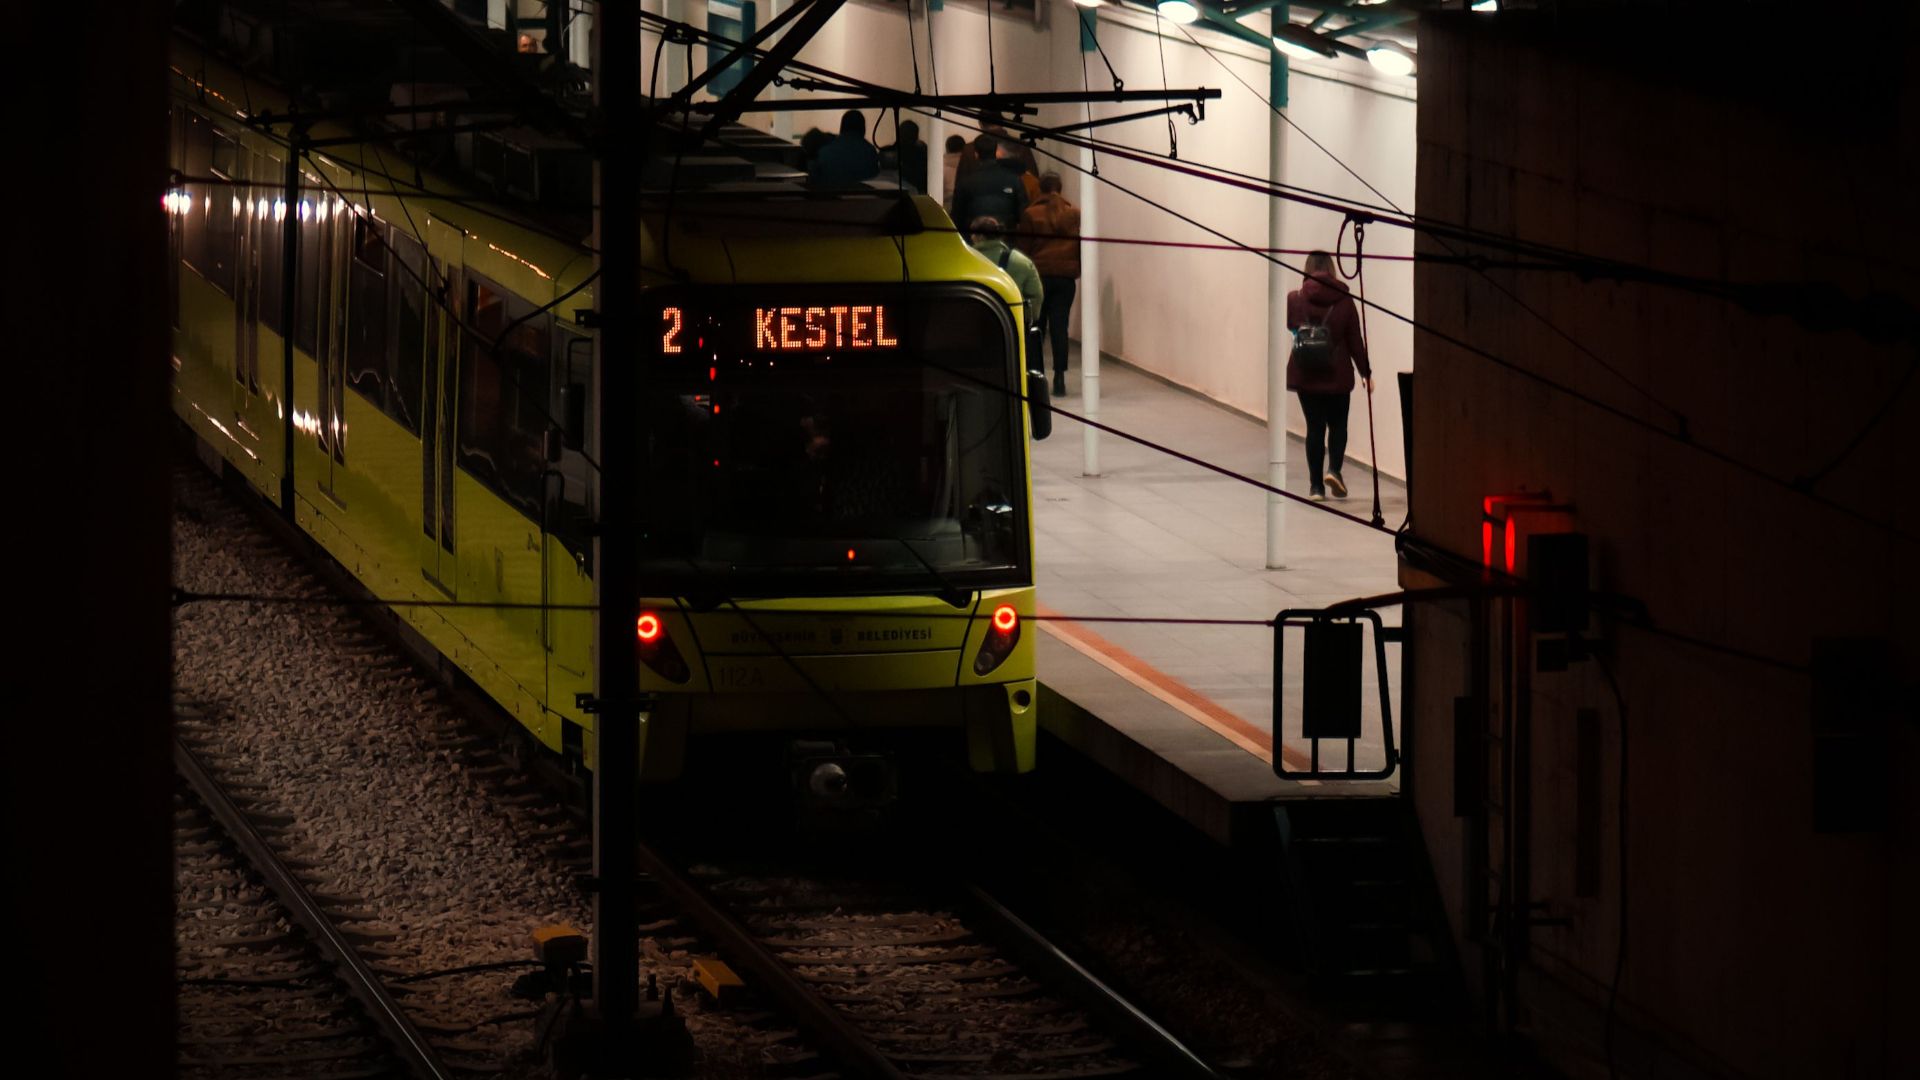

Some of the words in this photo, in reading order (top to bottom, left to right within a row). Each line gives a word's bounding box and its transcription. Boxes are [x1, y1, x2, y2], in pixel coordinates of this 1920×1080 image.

[662, 306, 683, 354] 2
[755, 304, 898, 349] KESTEL
[857, 626, 932, 641] BELEDİYESİ
